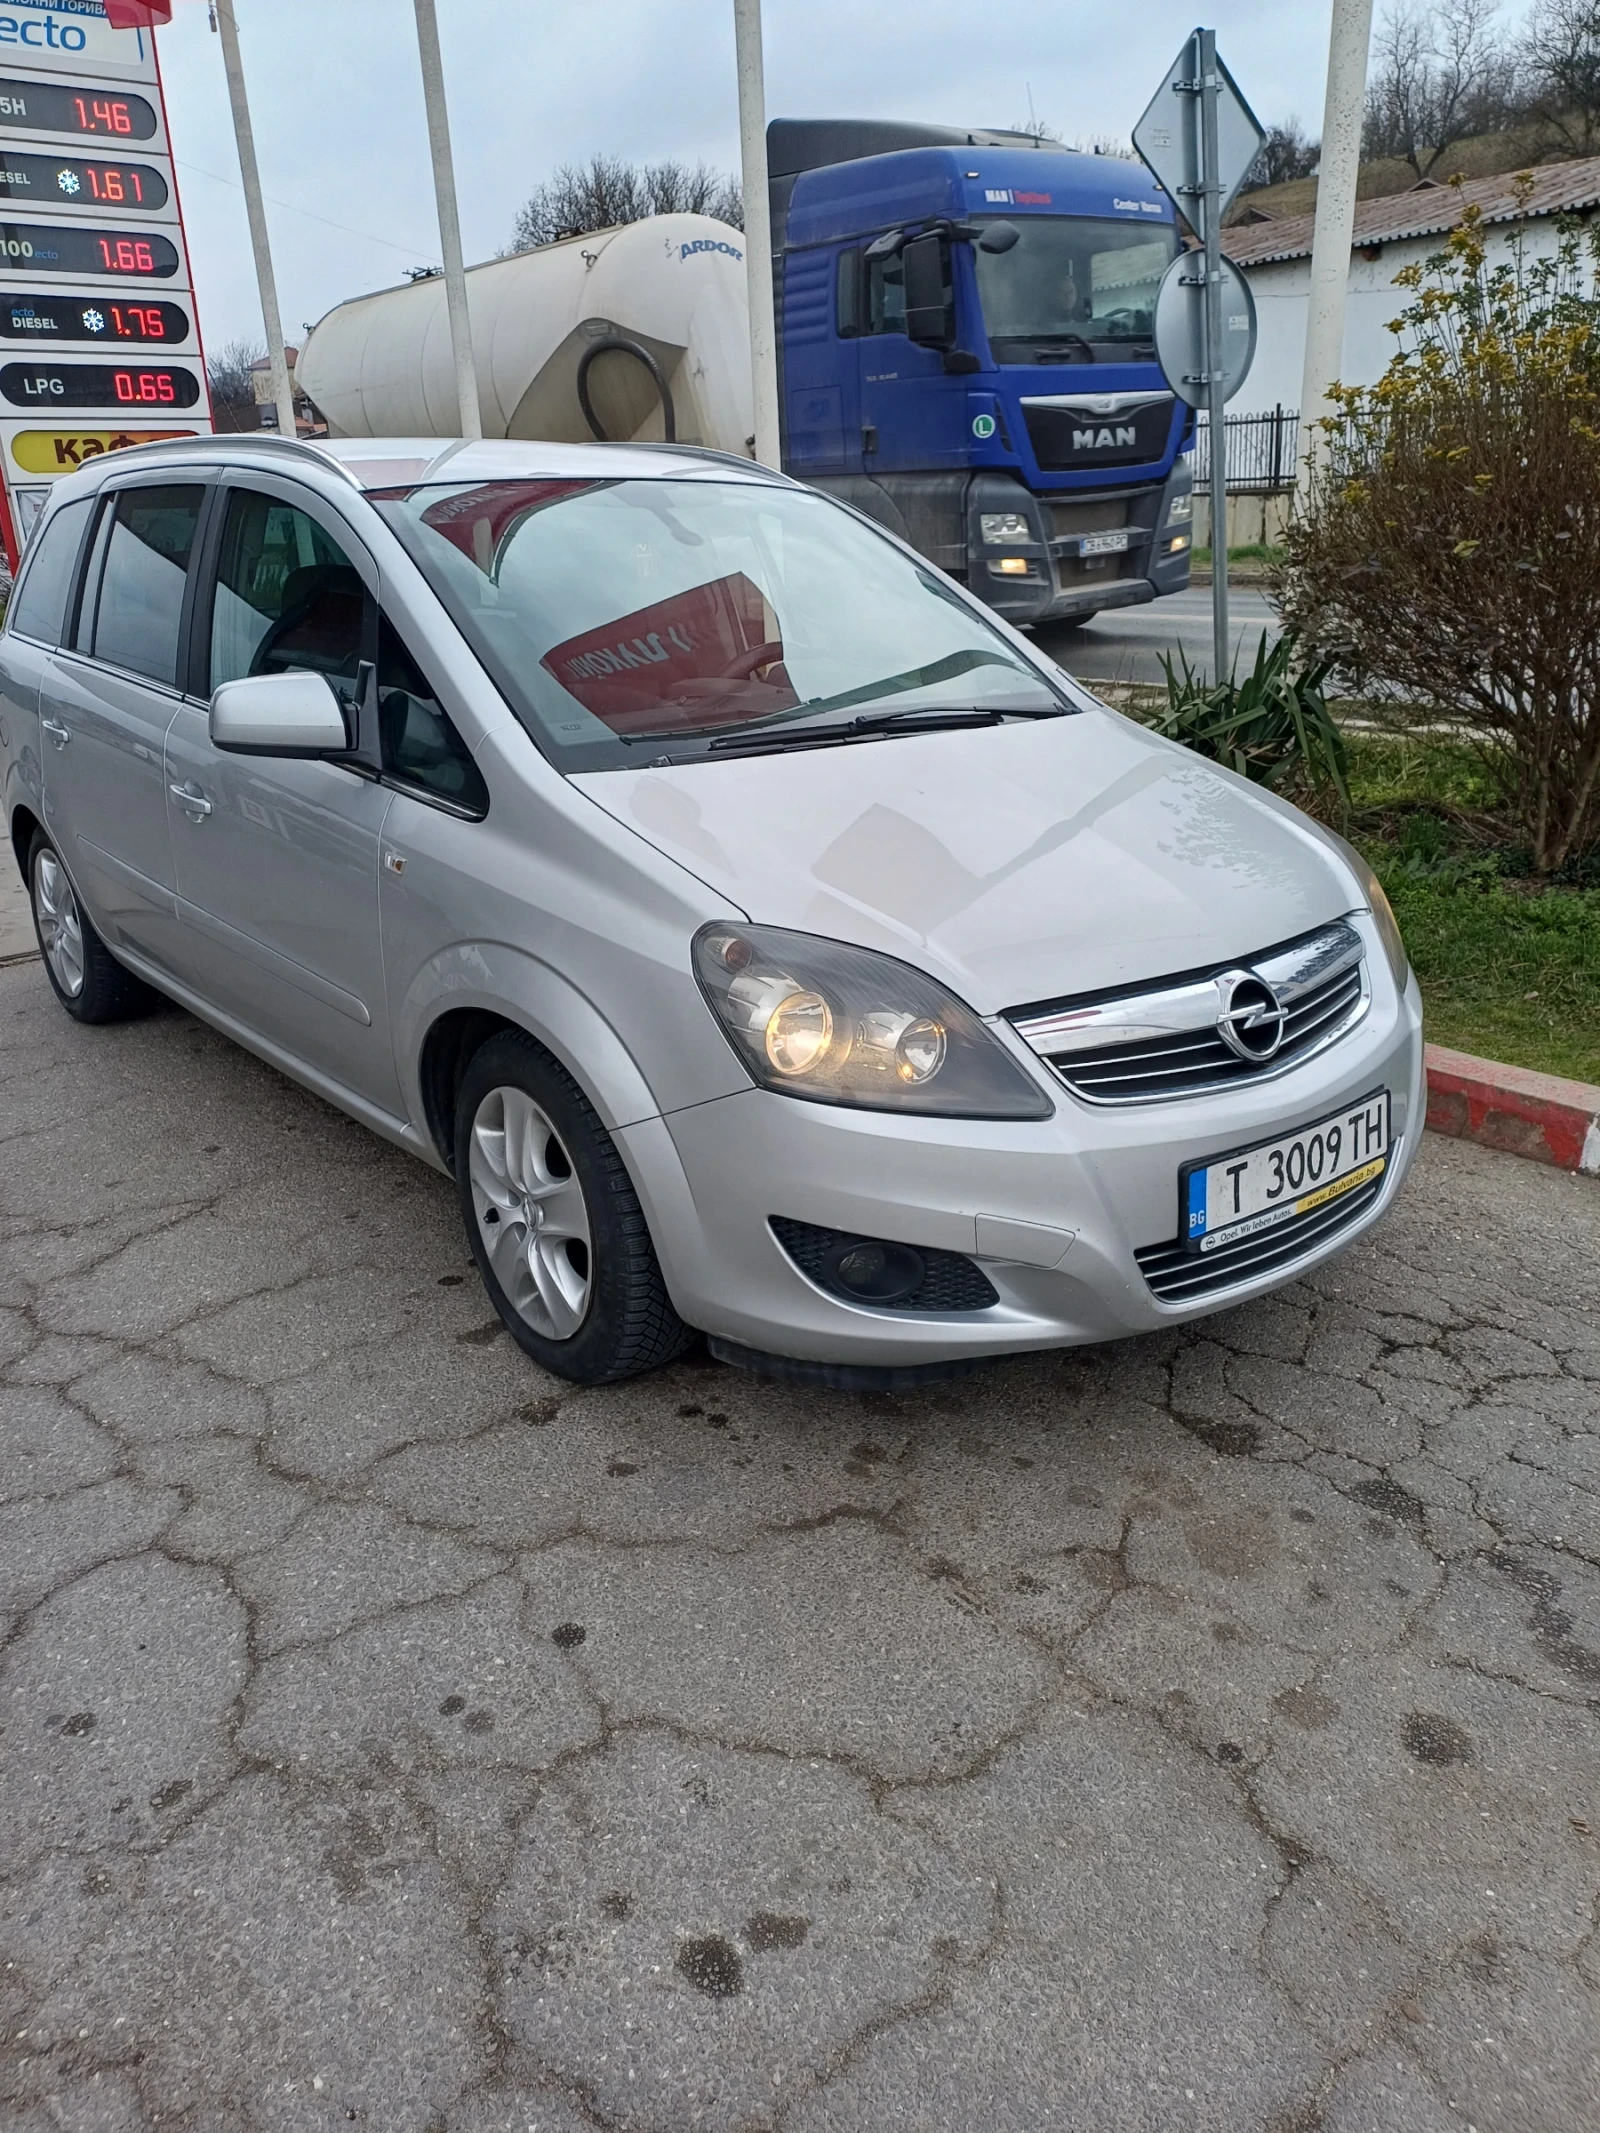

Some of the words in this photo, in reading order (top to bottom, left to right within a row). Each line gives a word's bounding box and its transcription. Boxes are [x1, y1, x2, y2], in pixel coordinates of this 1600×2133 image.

[0, 16, 86, 51] ecto
[75, 98, 131, 133] 1.46
[87, 169, 142, 202] 1.61
[35, 250, 58, 260] ecto
[100, 240, 153, 271] 1.66
[681, 240, 743, 262] ARDOR
[11, 308, 35, 317] ecto
[12, 318, 58, 330] DIESEL
[111, 307, 164, 336] 1.75
[24, 378, 65, 395] LPG
[114, 373, 175, 402] 0.65
[53, 435, 165, 464] ка
[1072, 426, 1136, 450] MAN
[1226, 1161, 1248, 1214] T
[1266, 1125, 1342, 1199] 3009
[1349, 1103, 1382, 1162] TH
[1189, 1209, 1205, 1229] BG
[1240, 1223, 1252, 1234] Wir
[1252, 1217, 1272, 1230] leben
